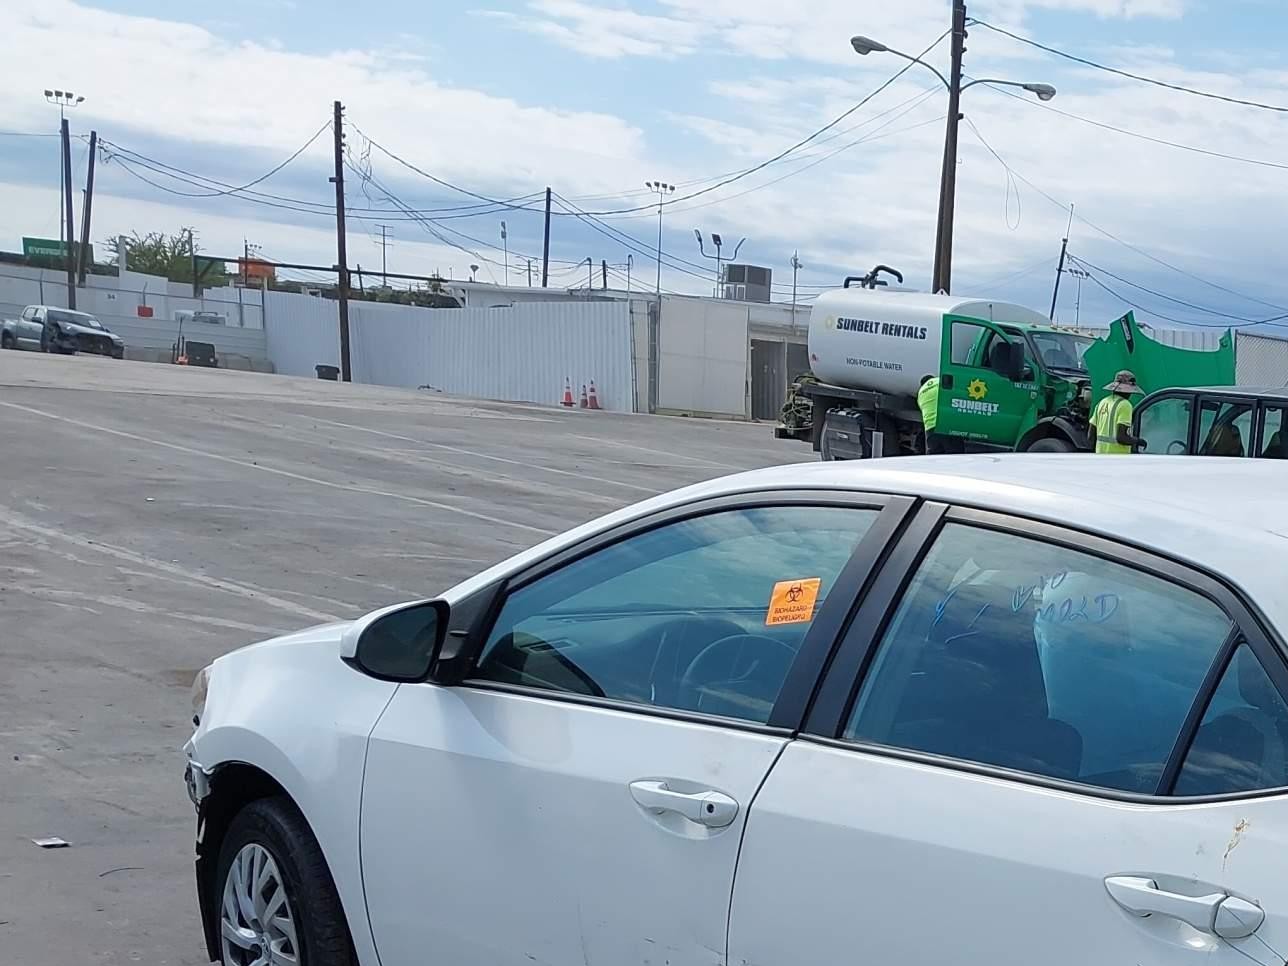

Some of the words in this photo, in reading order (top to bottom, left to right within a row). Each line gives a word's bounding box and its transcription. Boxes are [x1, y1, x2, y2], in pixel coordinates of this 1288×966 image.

[836, 317, 880, 334] SUNBELT
[881, 323, 928, 340] RENTALS
[846, 358, 883, 369] NON-POTABLE
[884, 361, 903, 371] WATER
[951, 398, 1000, 413] SUNBELT
[957, 408, 992, 417] RENTALS
